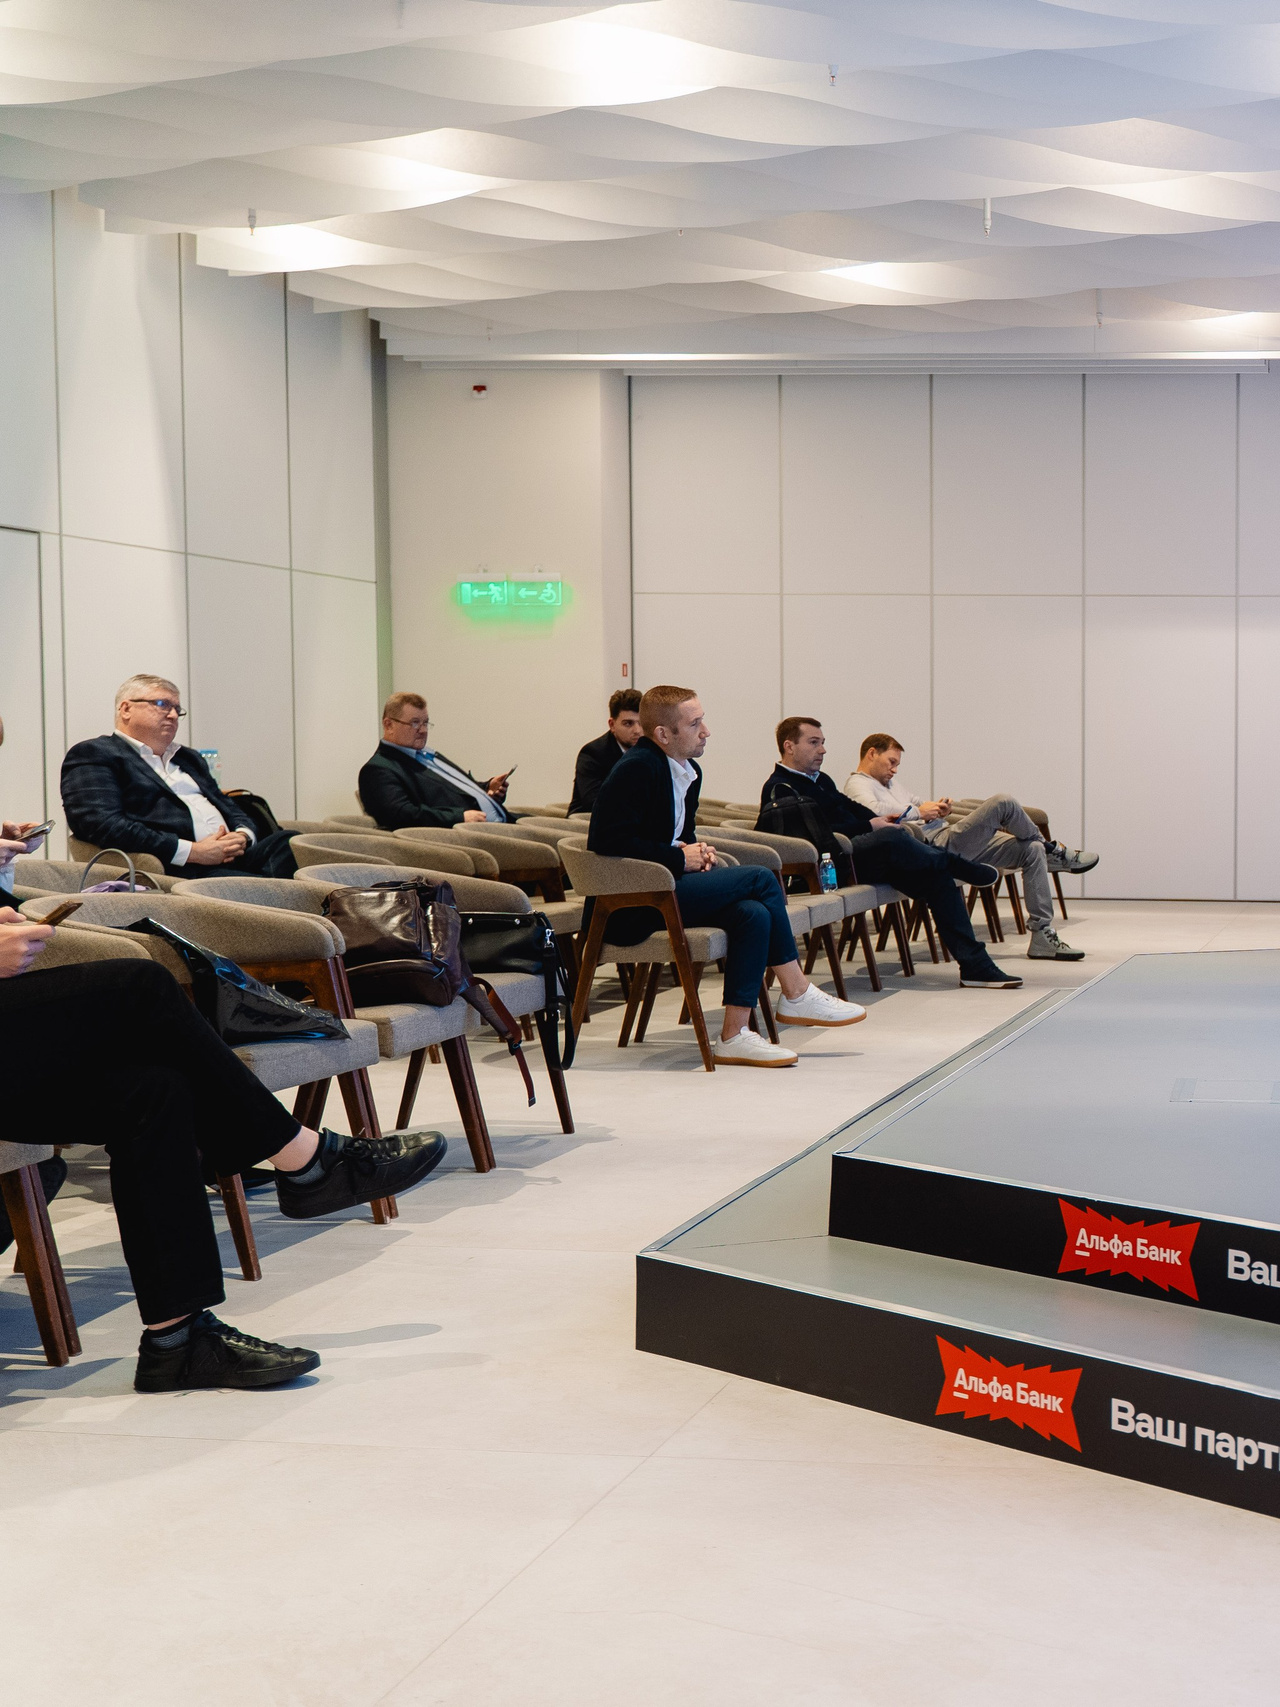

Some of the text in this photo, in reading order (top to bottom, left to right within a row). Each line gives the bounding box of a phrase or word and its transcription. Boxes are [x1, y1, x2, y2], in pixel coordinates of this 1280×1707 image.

[1075, 1227, 1182, 1266] Альфа Банк
[953, 1367, 1063, 1414] Альфа Банк
[1111, 1397, 1187, 1448] Ваш
